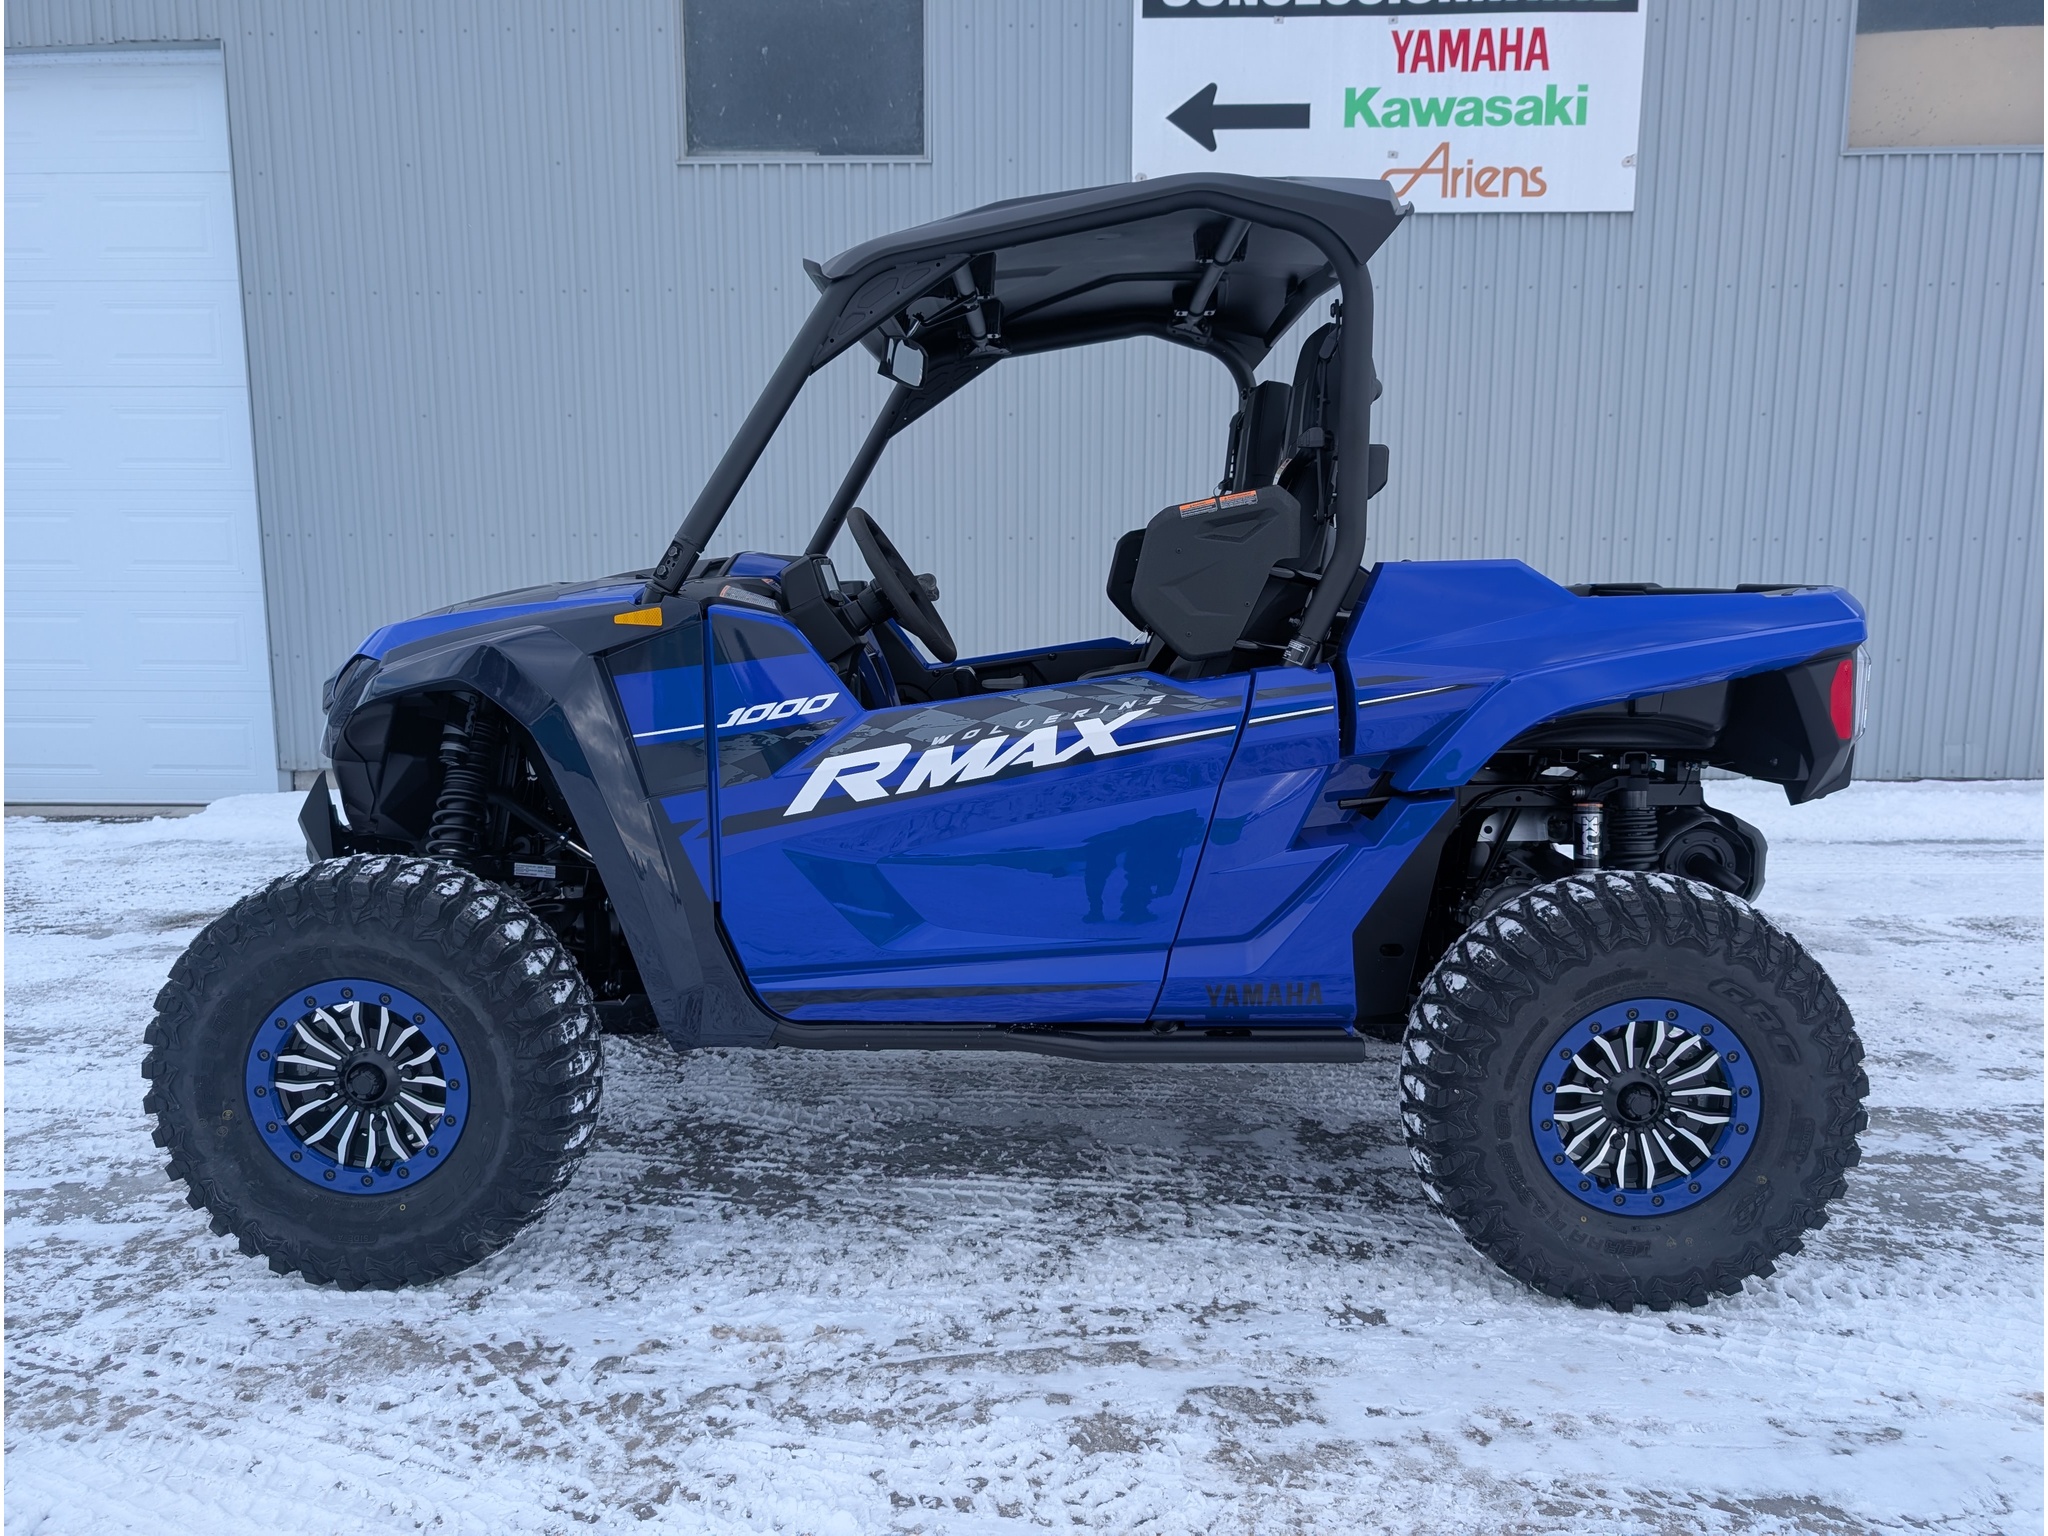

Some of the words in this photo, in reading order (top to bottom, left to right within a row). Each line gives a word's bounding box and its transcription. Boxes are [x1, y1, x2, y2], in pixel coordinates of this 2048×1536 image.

[1391, 27, 1550, 74] YAMAHA
[1343, 83, 1589, 128] Kawasaki
[1381, 141, 1548, 198] Ariens
[718, 692, 840, 729] 1000
[782, 707, 1153, 817] RMAX
[1581, 815, 1602, 856] FOX
[1205, 981, 1324, 1008] YAMAHA
[1708, 977, 1802, 1065] GBC
